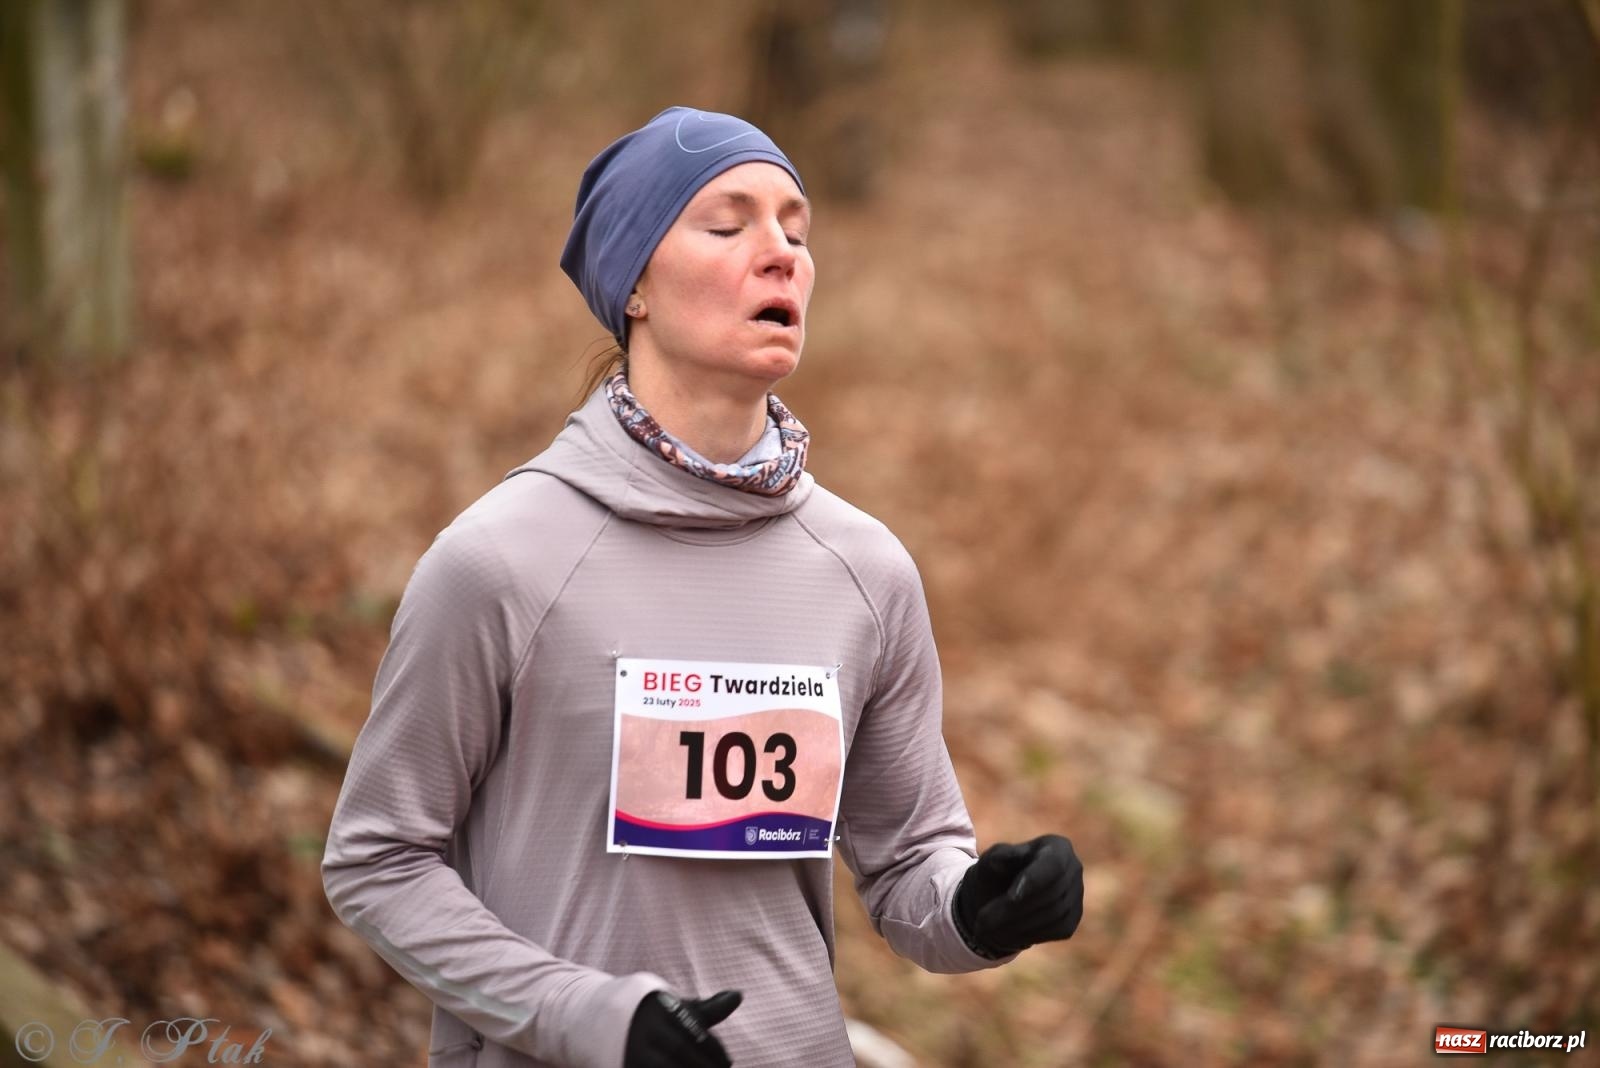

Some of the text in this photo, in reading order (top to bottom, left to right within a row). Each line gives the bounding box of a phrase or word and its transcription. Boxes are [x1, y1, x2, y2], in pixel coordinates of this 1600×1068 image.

[643, 671, 824, 698] BIEG Twardziela
[643, 697, 701, 709] 23 luty 2025
[679, 730, 798, 803] 103
[758, 828, 802, 841] Racibórz
